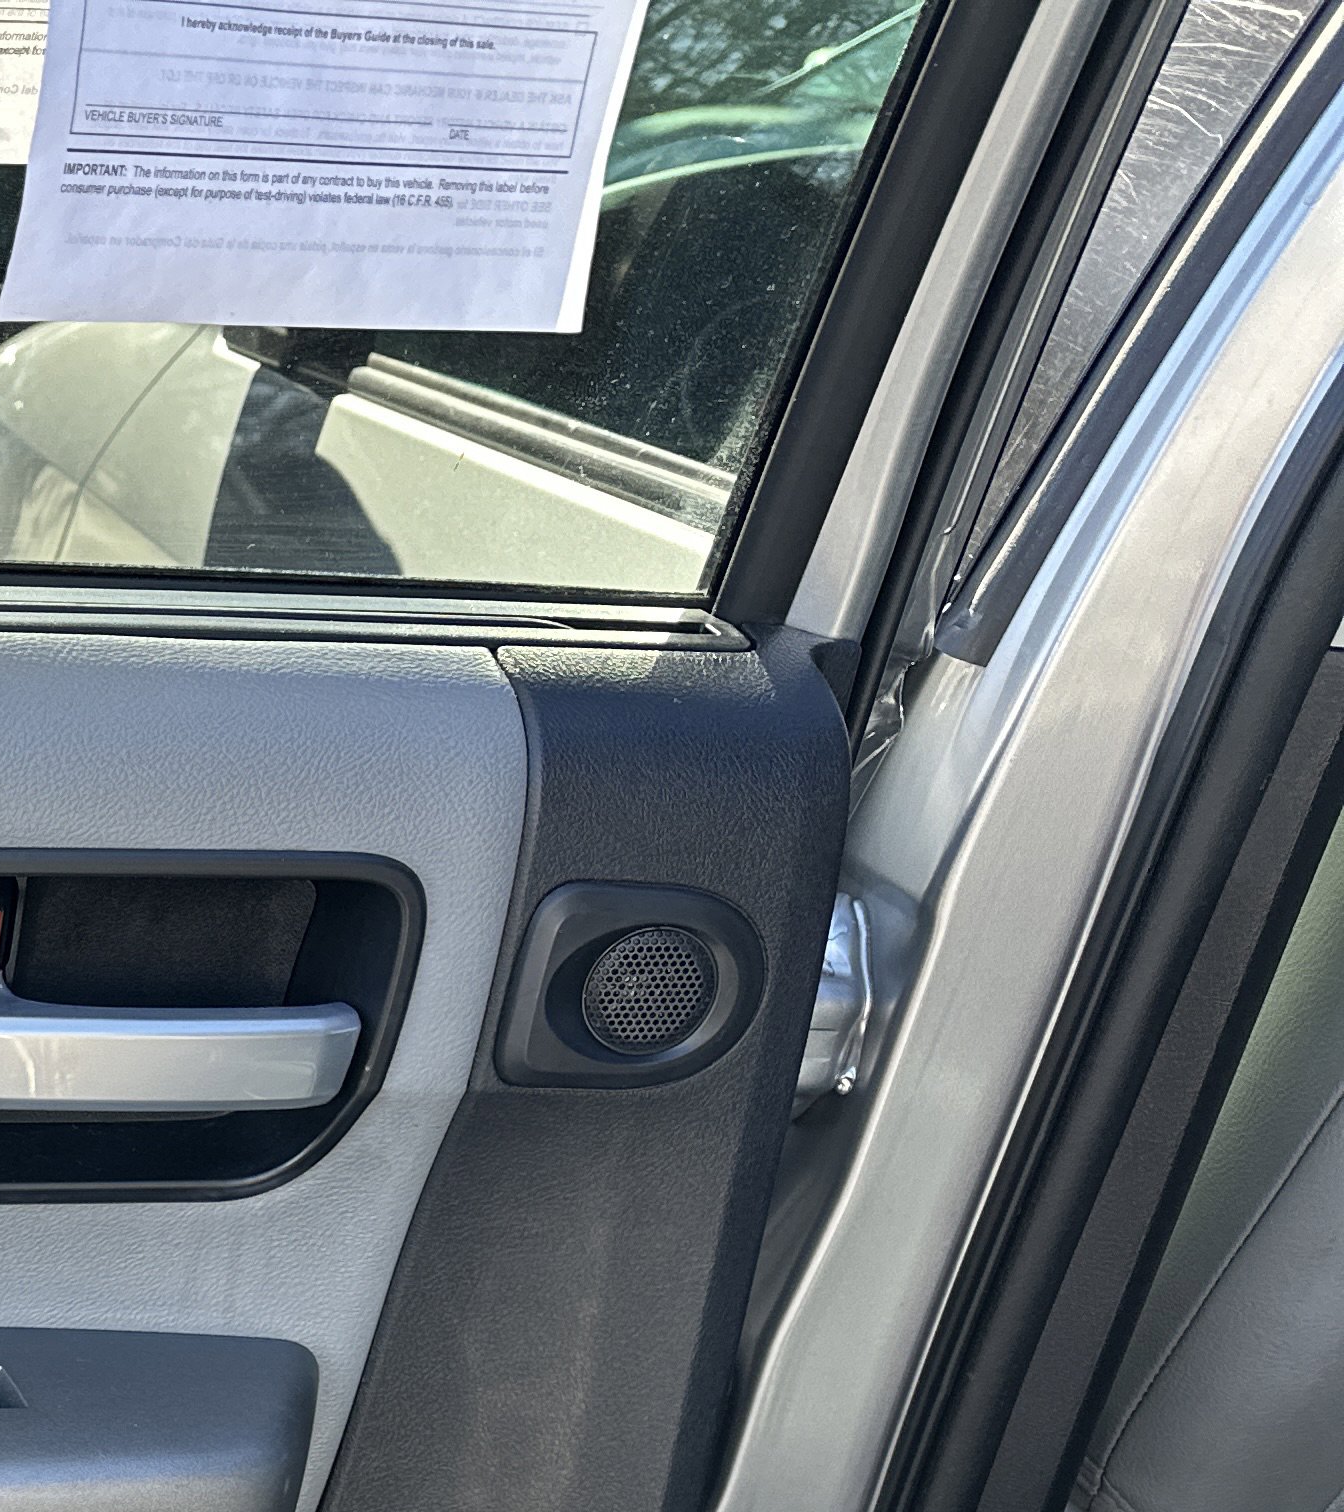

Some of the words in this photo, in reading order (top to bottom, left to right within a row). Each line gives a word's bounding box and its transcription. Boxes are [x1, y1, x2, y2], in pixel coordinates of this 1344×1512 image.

[181, 16, 185, 28] I
[185, 17, 216, 32] hereby
[217, 20, 273, 37] acknowledge
[273, 23, 303, 38] receipt
[304, 25, 314, 38] of
[314, 27, 329, 39] the
[330, 28, 362, 43] Buyers
[364, 30, 391, 43] Guide
[392, 32, 401, 44] at
[402, 33, 416, 45] the
[417, 35, 449, 50] closing
[449, 36, 459, 47] of
[459, 37, 474, 49] this
[475, 40, 497, 51] sale.
[84, 109, 125, 123] VEHICLE
[127, 111, 168, 125] BUYER'S
[169, 113, 224, 128] SIGNATURE
[448, 128, 470, 140] DATE
[63, 163, 127, 176] IMPORTANT:
[133, 165, 152, 178] The
[153, 166, 206, 180] information
[208, 171, 220, 182] on
[222, 170, 238, 182] this
[240, 169, 260, 183] form
[261, 172, 270, 183] is
[271, 172, 290, 186] part
[291, 172, 302, 184] of
[302, 175, 317, 188] any
[318, 175, 355, 188] contract
[356, 176, 365, 188] to
[366, 176, 382, 191] buy
[384, 176, 400, 189] this
[403, 177, 435, 190] vehicle.
[438, 178, 478, 194] Removing
[478, 180, 494, 192] this
[495, 180, 518, 193] label
[519, 181, 550, 195] before
[60, 183, 106, 195] consumer
[107, 184, 153, 197] purchase
[154, 184, 189, 199] (except
[190, 186, 204, 198] for
[204, 189, 242, 201] purpose
[243, 188, 254, 200] of
[254, 189, 307, 205] test-driving)
[308, 191, 342, 204] violates
[344, 191, 374, 205] federal
[375, 193, 391, 204] law
[392, 193, 407, 208] (16
